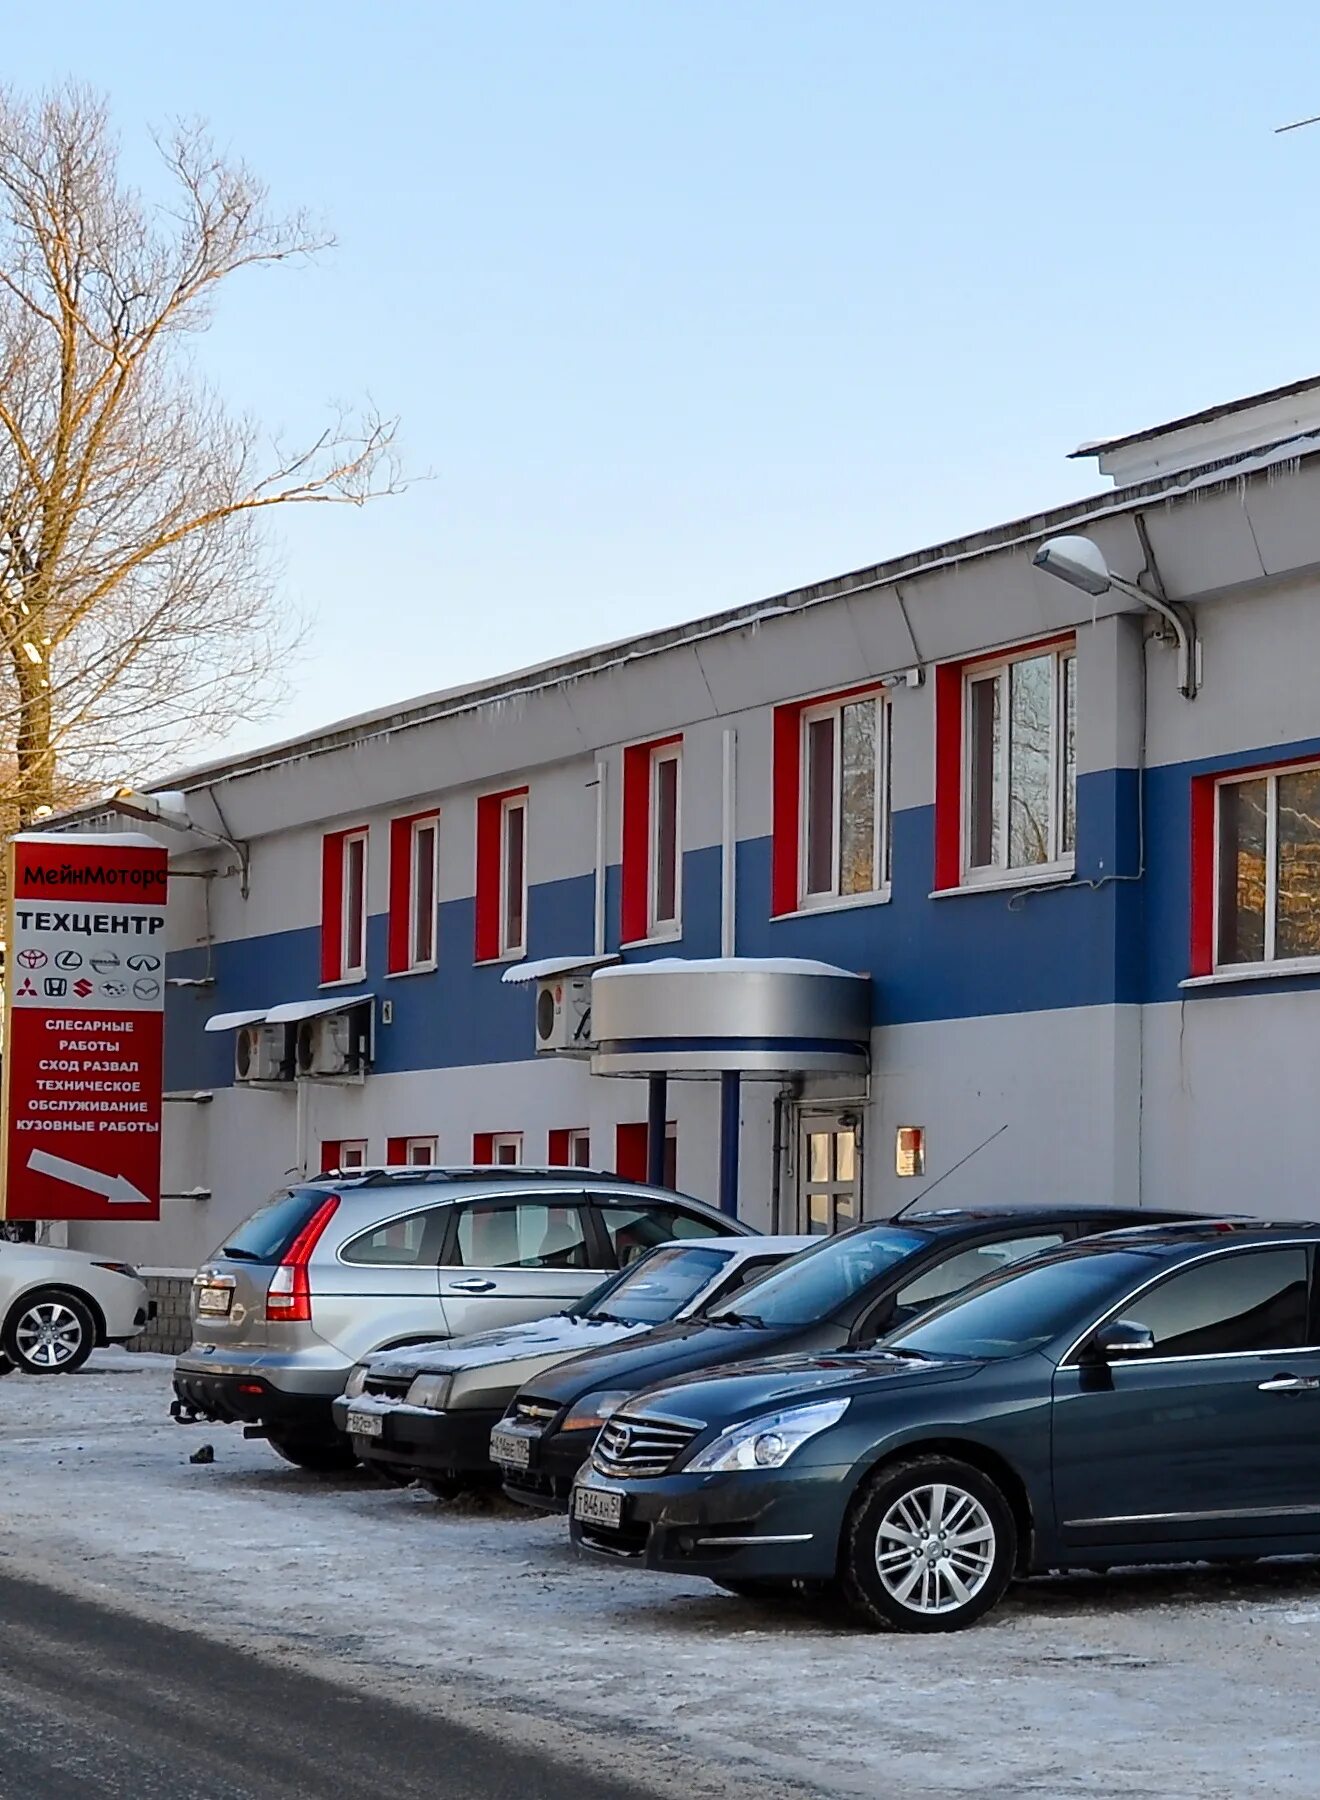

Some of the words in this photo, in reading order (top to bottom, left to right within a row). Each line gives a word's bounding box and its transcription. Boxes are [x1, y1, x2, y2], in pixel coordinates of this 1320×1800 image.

[24, 864, 167, 889] МейнМоторс
[16, 911, 164, 936] ТЕХЦЕНТР
[45, 1019, 134, 1032] СЛЕСАРНЫЕ
[59, 1039, 120, 1052] РАБОТЫ
[38, 1059, 80, 1073] СХОД
[82, 1060, 139, 1073] РАЗВАЛ
[36, 1079, 141, 1092] ТЕХНИЧЕСКОЕ
[28, 1099, 149, 1113] ОБСЛУЖИВАНИЕ
[16, 1119, 95, 1132] КУЗОВНЫЕ
[99, 1120, 159, 1133] РАБОТЫ
